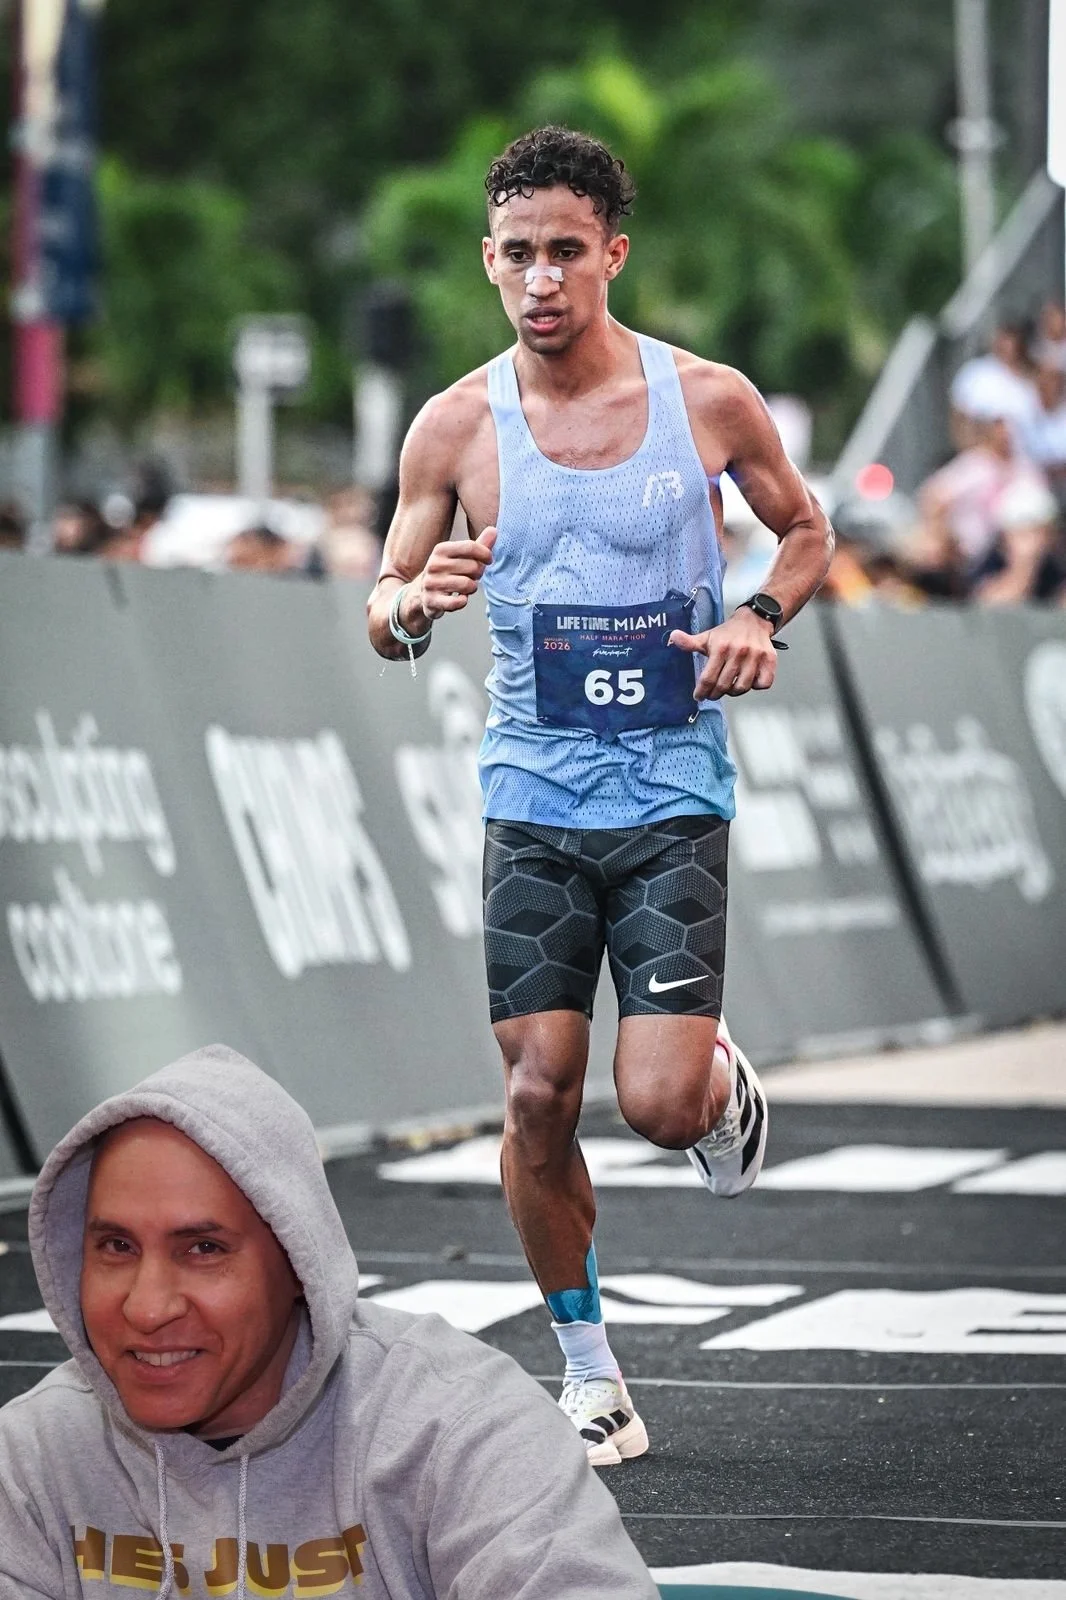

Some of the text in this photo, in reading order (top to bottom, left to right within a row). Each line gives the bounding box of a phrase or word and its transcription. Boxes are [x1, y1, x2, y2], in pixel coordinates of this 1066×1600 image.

[614, 612, 667, 631] MIAMI
[543, 641, 571, 651] 2026
[602, 633, 646, 642] MARATHON
[584, 668, 646, 706] 65
[203, 1523, 368, 1600] JUST
